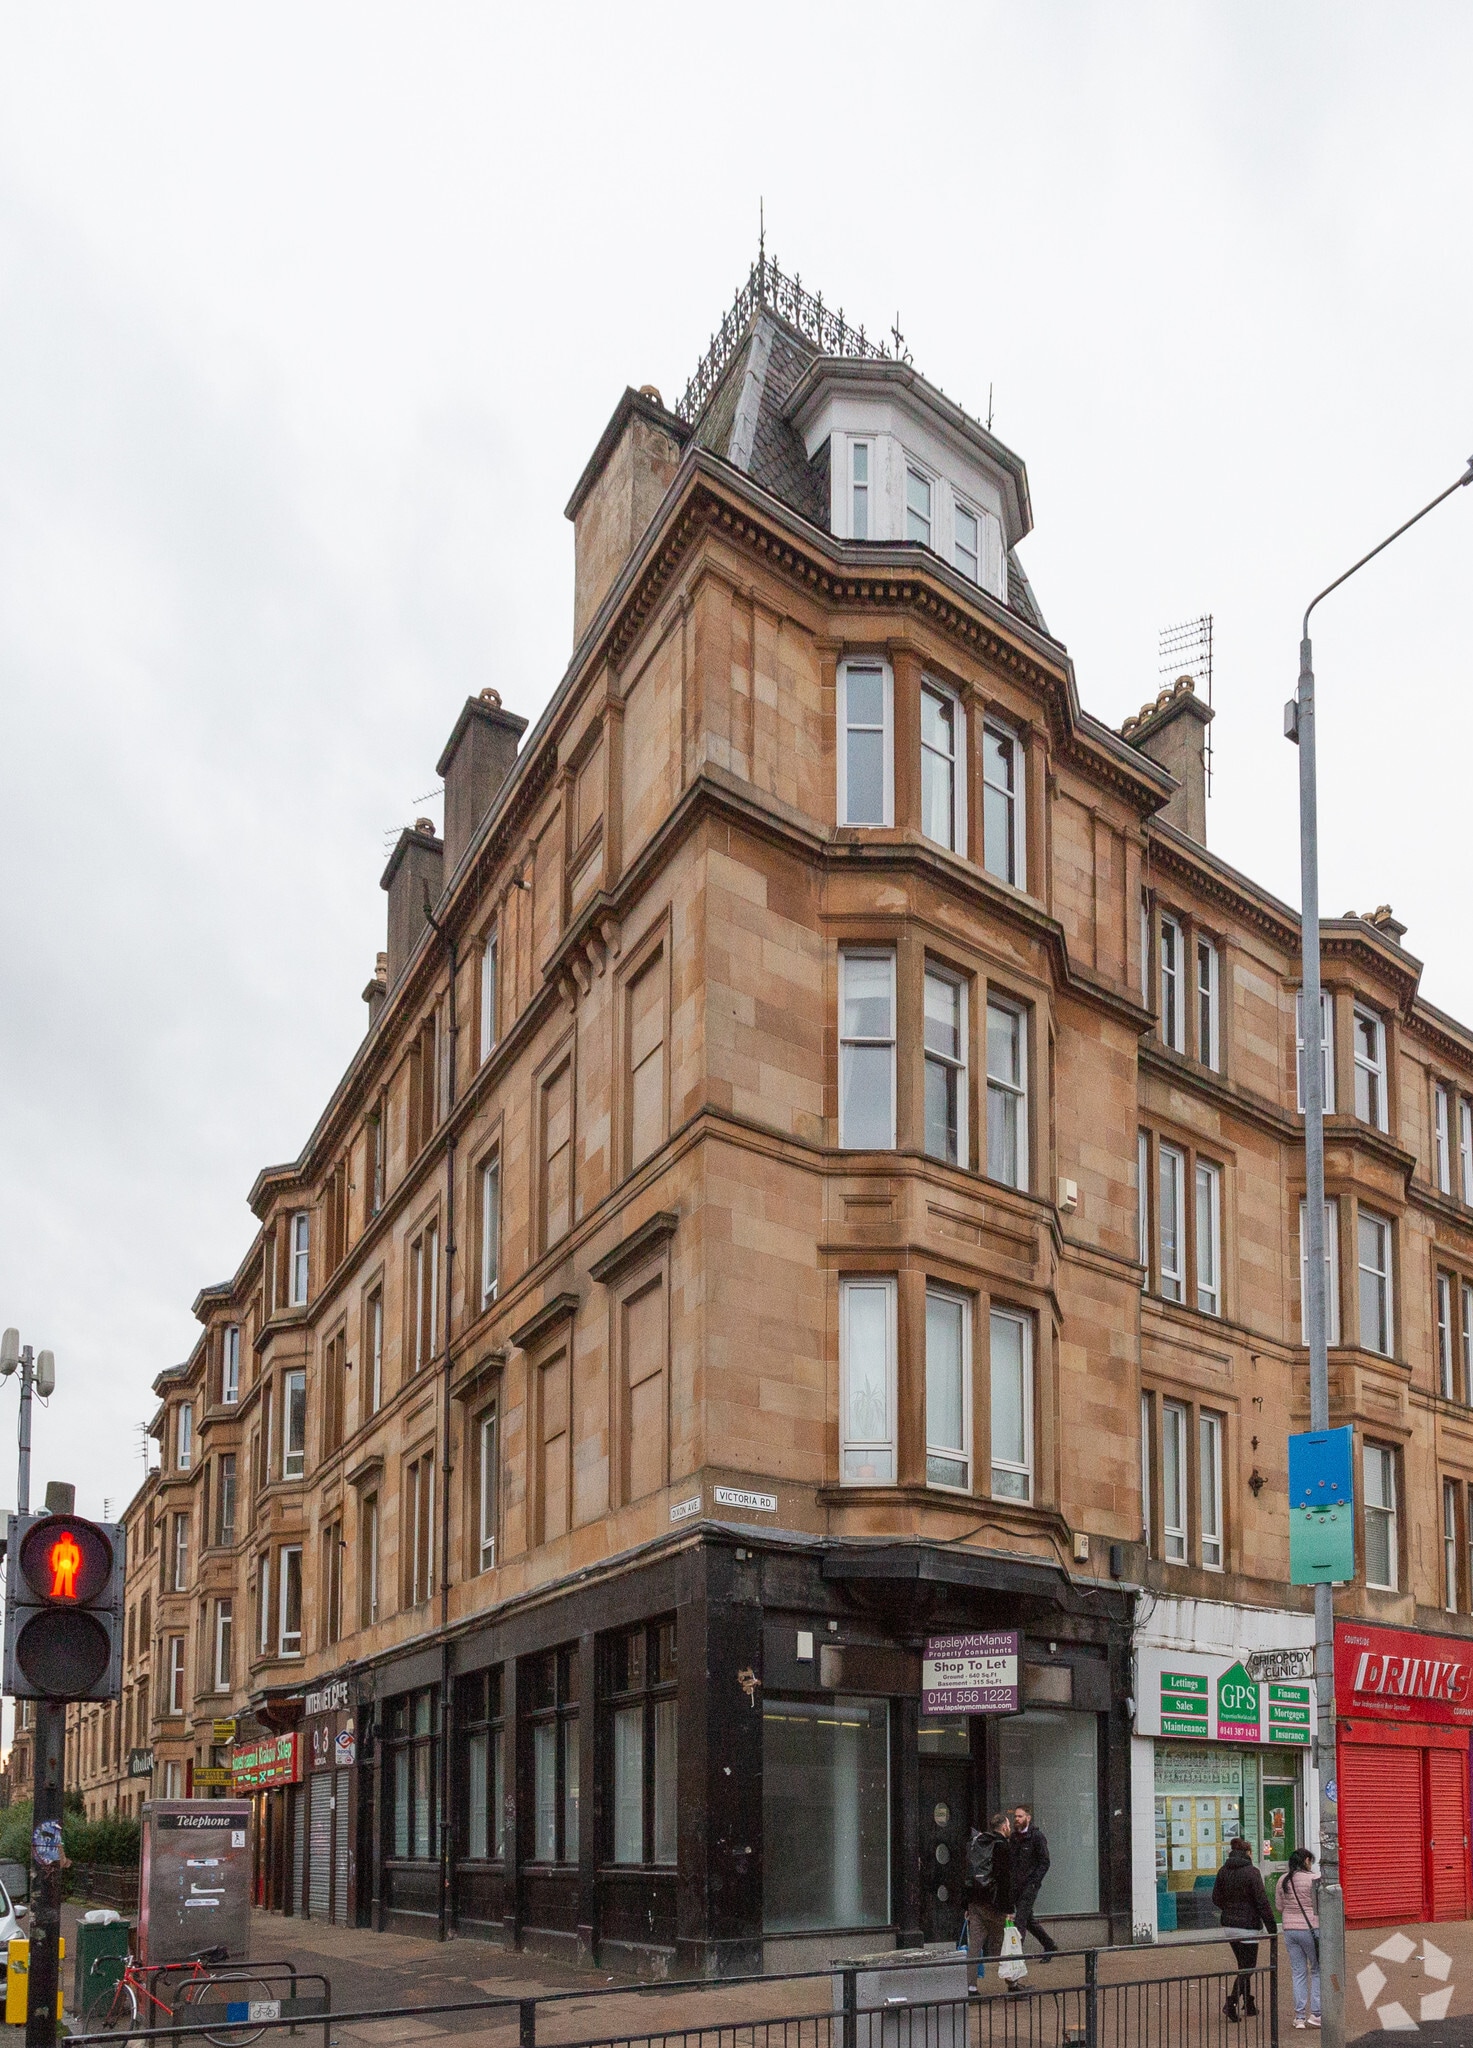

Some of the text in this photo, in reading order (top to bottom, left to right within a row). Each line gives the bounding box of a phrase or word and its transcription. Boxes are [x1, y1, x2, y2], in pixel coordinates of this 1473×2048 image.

[719, 1490, 773, 1508] VICTORIA RD.
[672, 1502, 699, 1519] DIXON AVE.
[929, 1634, 1012, 1651] LapsleyMcManus
[1344, 1635, 1370, 1646] SOUTHSIDE
[929, 1647, 1012, 1658] Property Consultants
[1252, 1651, 1311, 1666] CHIROPODY
[934, 1659, 1006, 1673] Shop To Let
[1265, 1665, 1298, 1676] CLINIC
[1171, 1677, 1199, 1691] Lettings
[1354, 1652, 1473, 1702] DRINKS
[928, 1688, 1012, 1704] 0141 556 1222
[1221, 1684, 1256, 1710] GPS
[1277, 1688, 1301, 1700] Finance
[928, 1703, 1011, 1712] www.lapsleymcmanus.com
[1176, 1700, 1193, 1711] Sales
[1274, 1708, 1305, 1723] Mortgages
[1163, 1720, 1207, 1734] Maintenance
[1219, 1726, 1258, 1737] 0141 387 1431
[1275, 1729, 1305, 1740] Insurance
[176, 1815, 231, 1828] Telephone
